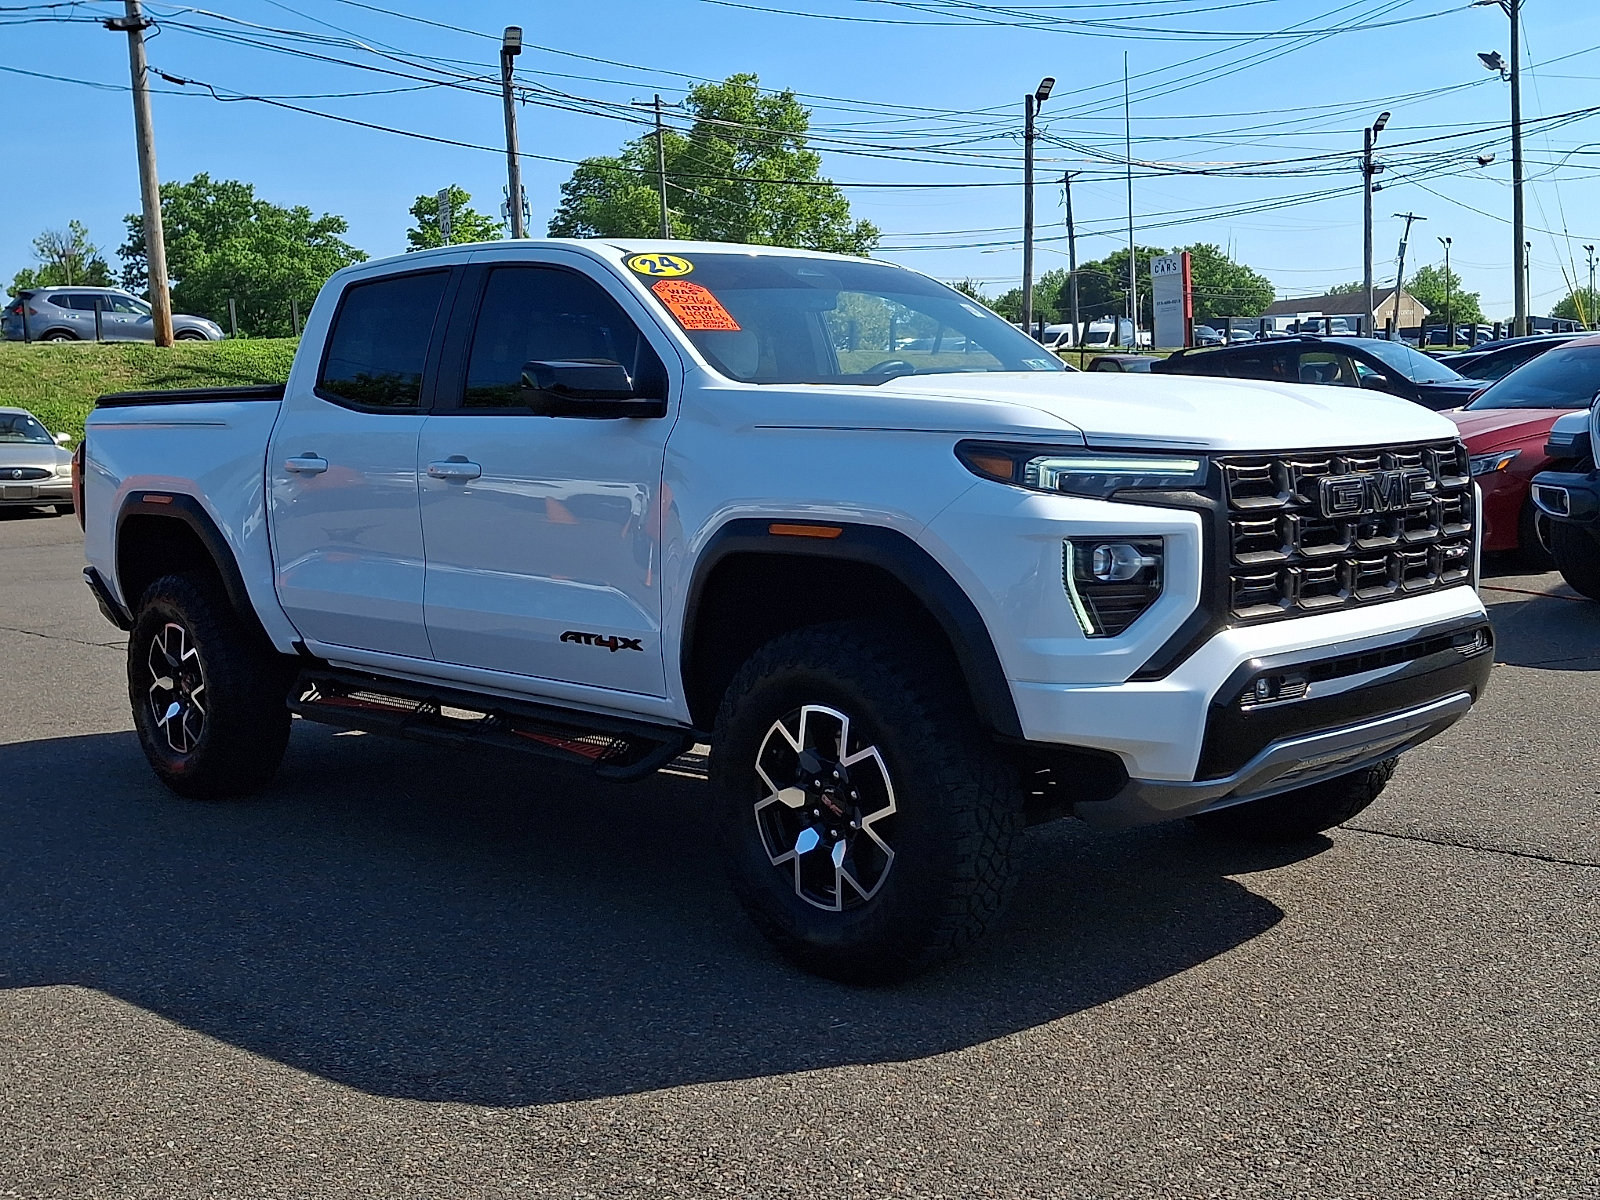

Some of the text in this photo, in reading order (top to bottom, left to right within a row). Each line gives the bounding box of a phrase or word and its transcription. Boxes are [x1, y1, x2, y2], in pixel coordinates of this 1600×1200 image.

[640, 256, 682, 273] 24
[1154, 263, 1177, 273] CARS
[1319, 468, 1433, 518] GMC
[560, 631, 644, 652] AT4X
